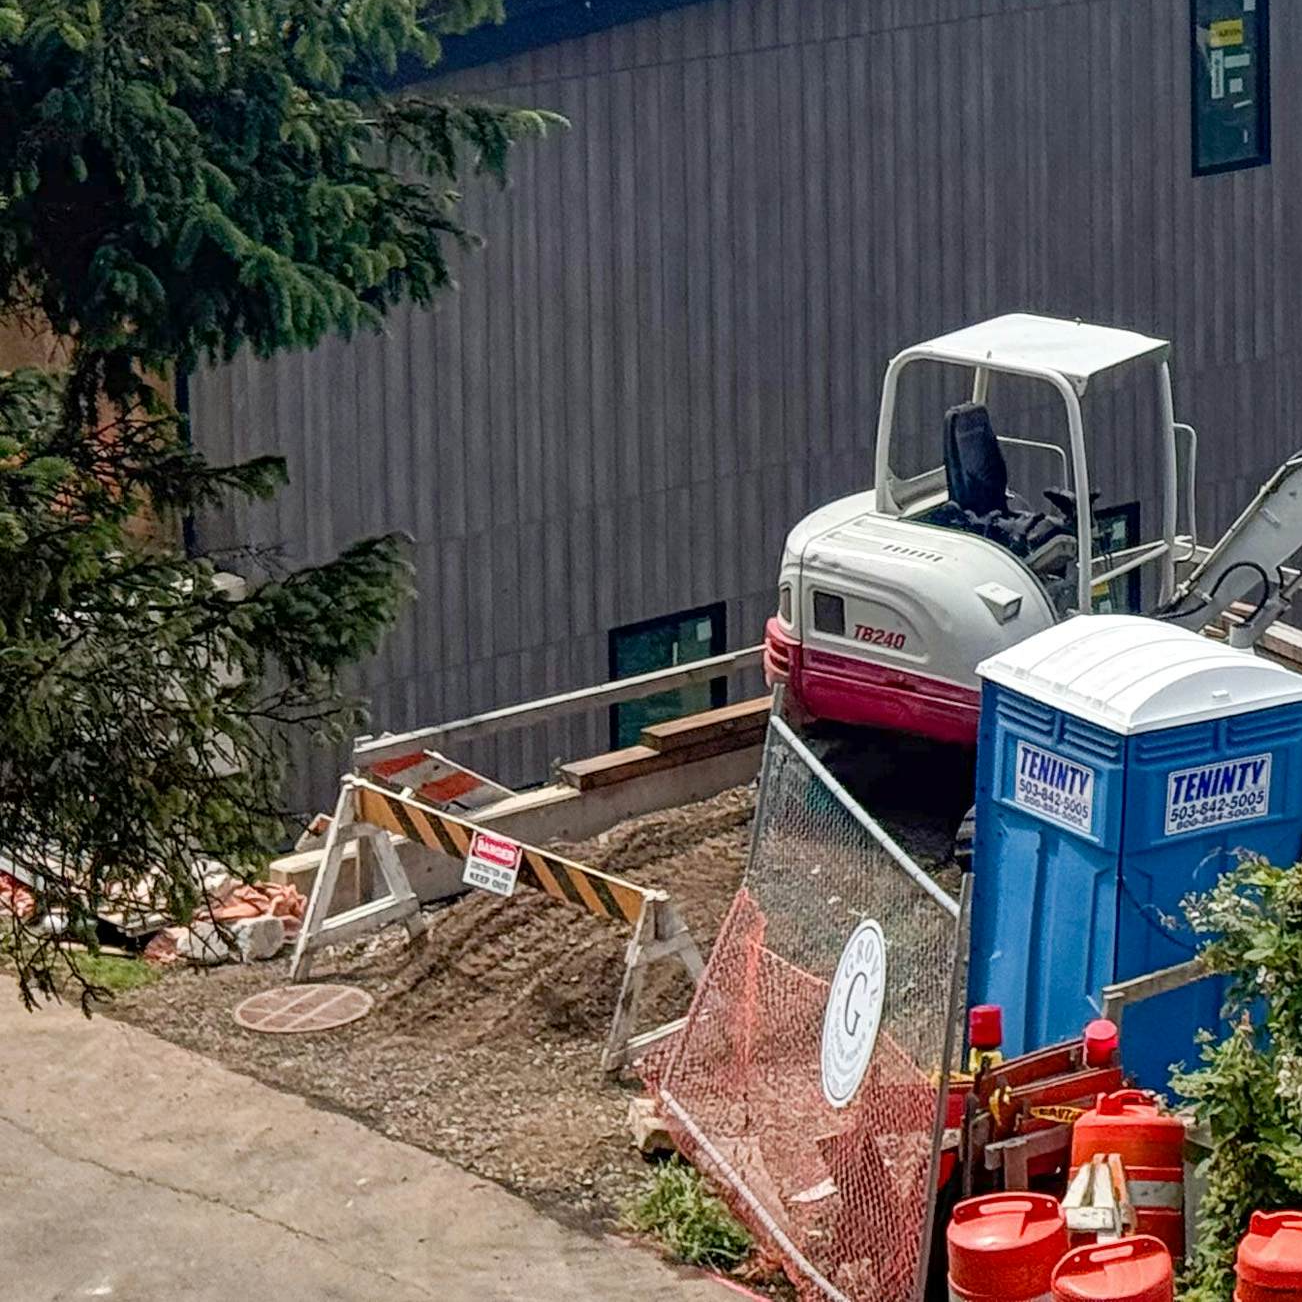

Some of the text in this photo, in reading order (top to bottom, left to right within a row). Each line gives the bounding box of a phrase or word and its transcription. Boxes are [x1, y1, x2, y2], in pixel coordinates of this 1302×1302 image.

[854, 623, 906, 650] TB240
[1020, 746, 1090, 796] TENINTY
[1172, 759, 1266, 805] TENINTY
[1019, 778, 1089, 819] 503-842-5005
[1170, 790, 1265, 822] 503-842-5005
[844, 971, 868, 1036] G
